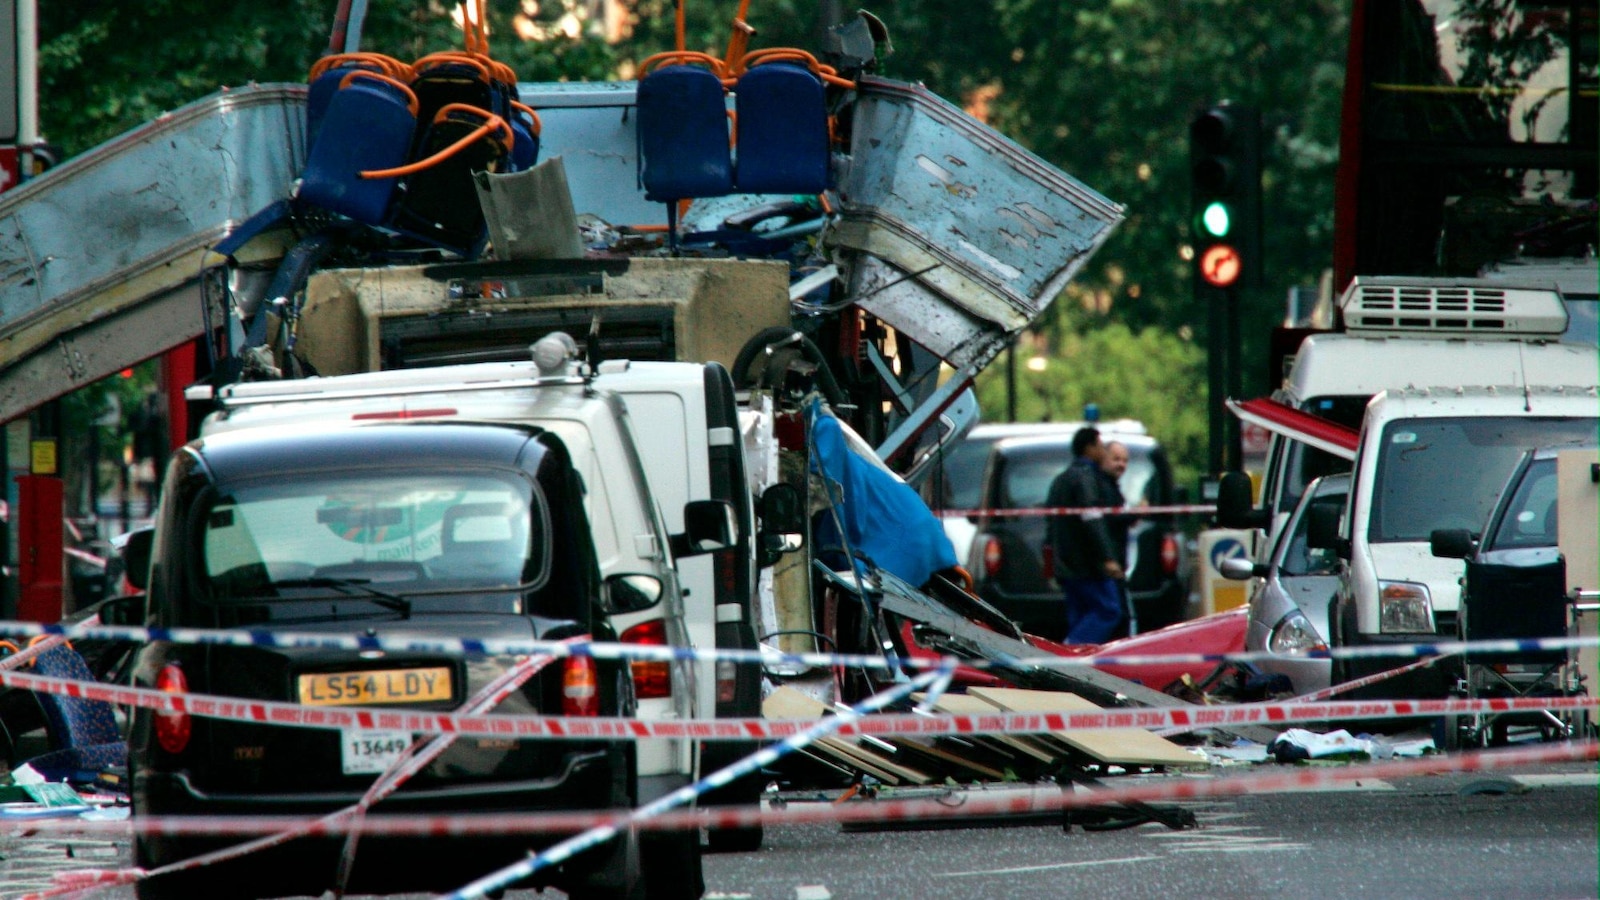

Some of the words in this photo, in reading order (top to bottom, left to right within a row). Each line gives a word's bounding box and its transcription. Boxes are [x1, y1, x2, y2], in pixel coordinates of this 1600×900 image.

[311, 675, 378, 701] LS54
[387, 672, 437, 697] LDY
[351, 739, 405, 756] 13649
